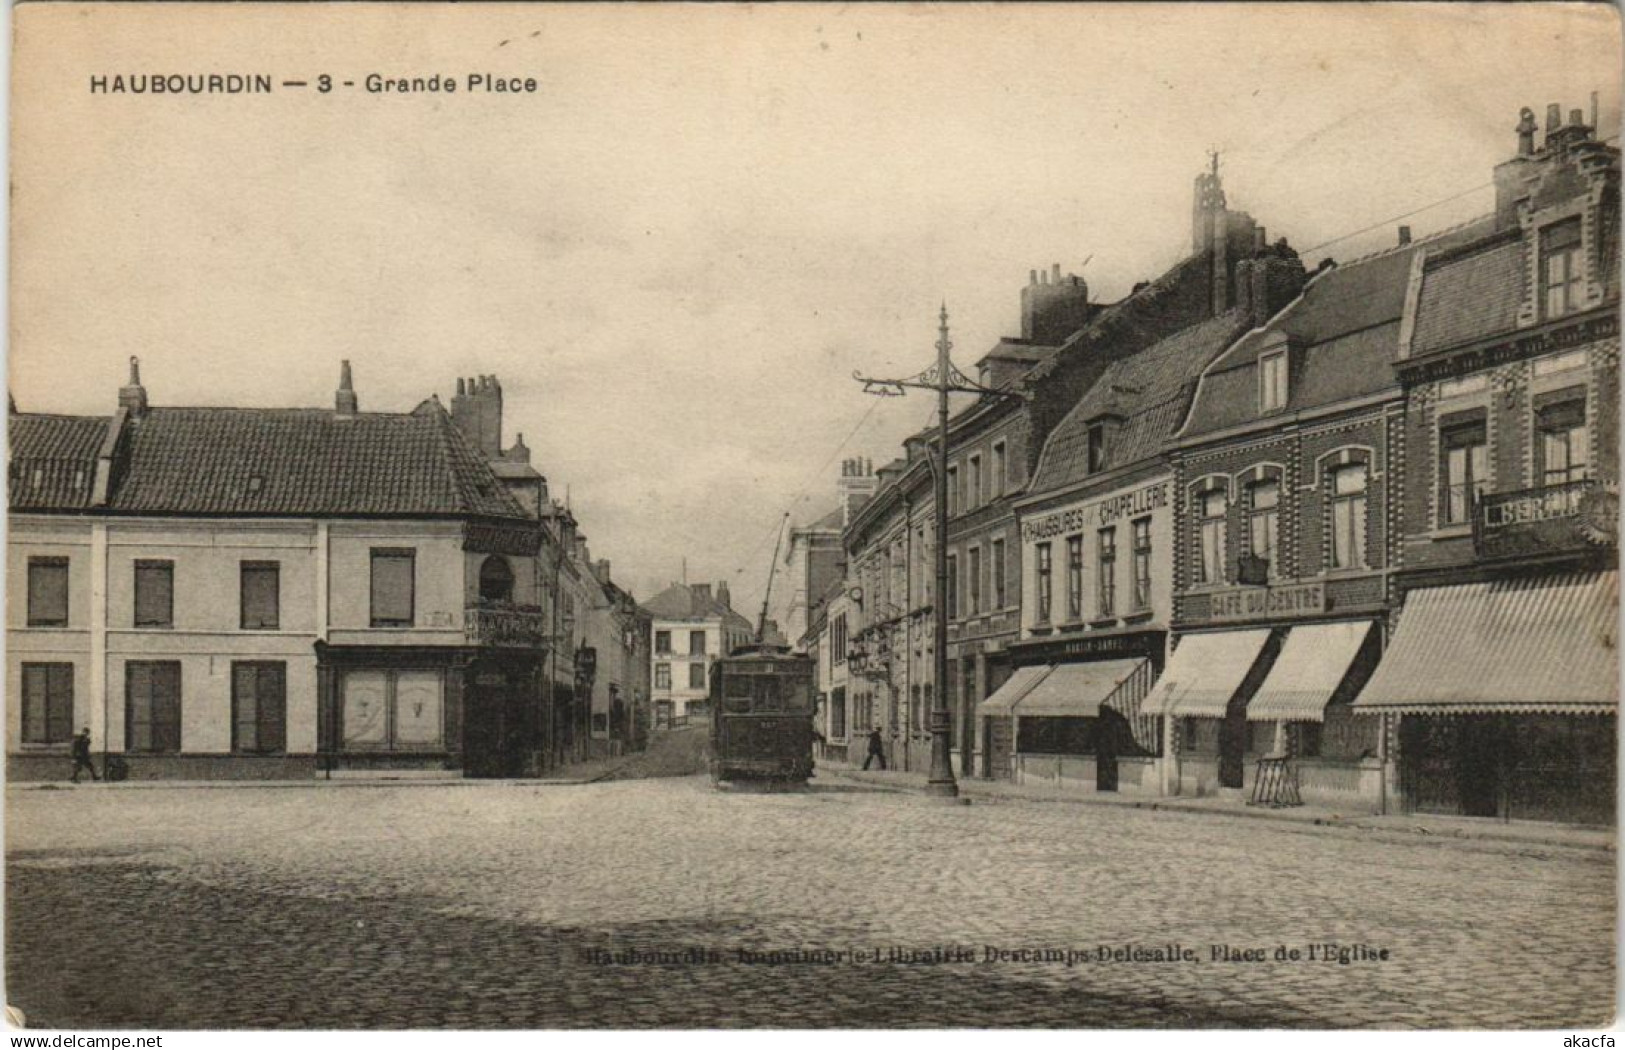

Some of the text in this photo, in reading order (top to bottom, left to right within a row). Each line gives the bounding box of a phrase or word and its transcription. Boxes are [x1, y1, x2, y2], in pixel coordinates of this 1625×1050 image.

[1023, 483, 1168, 544] CHAUSSURES CHAPELLERIE
[1269, 587, 1321, 612] CENTRE
